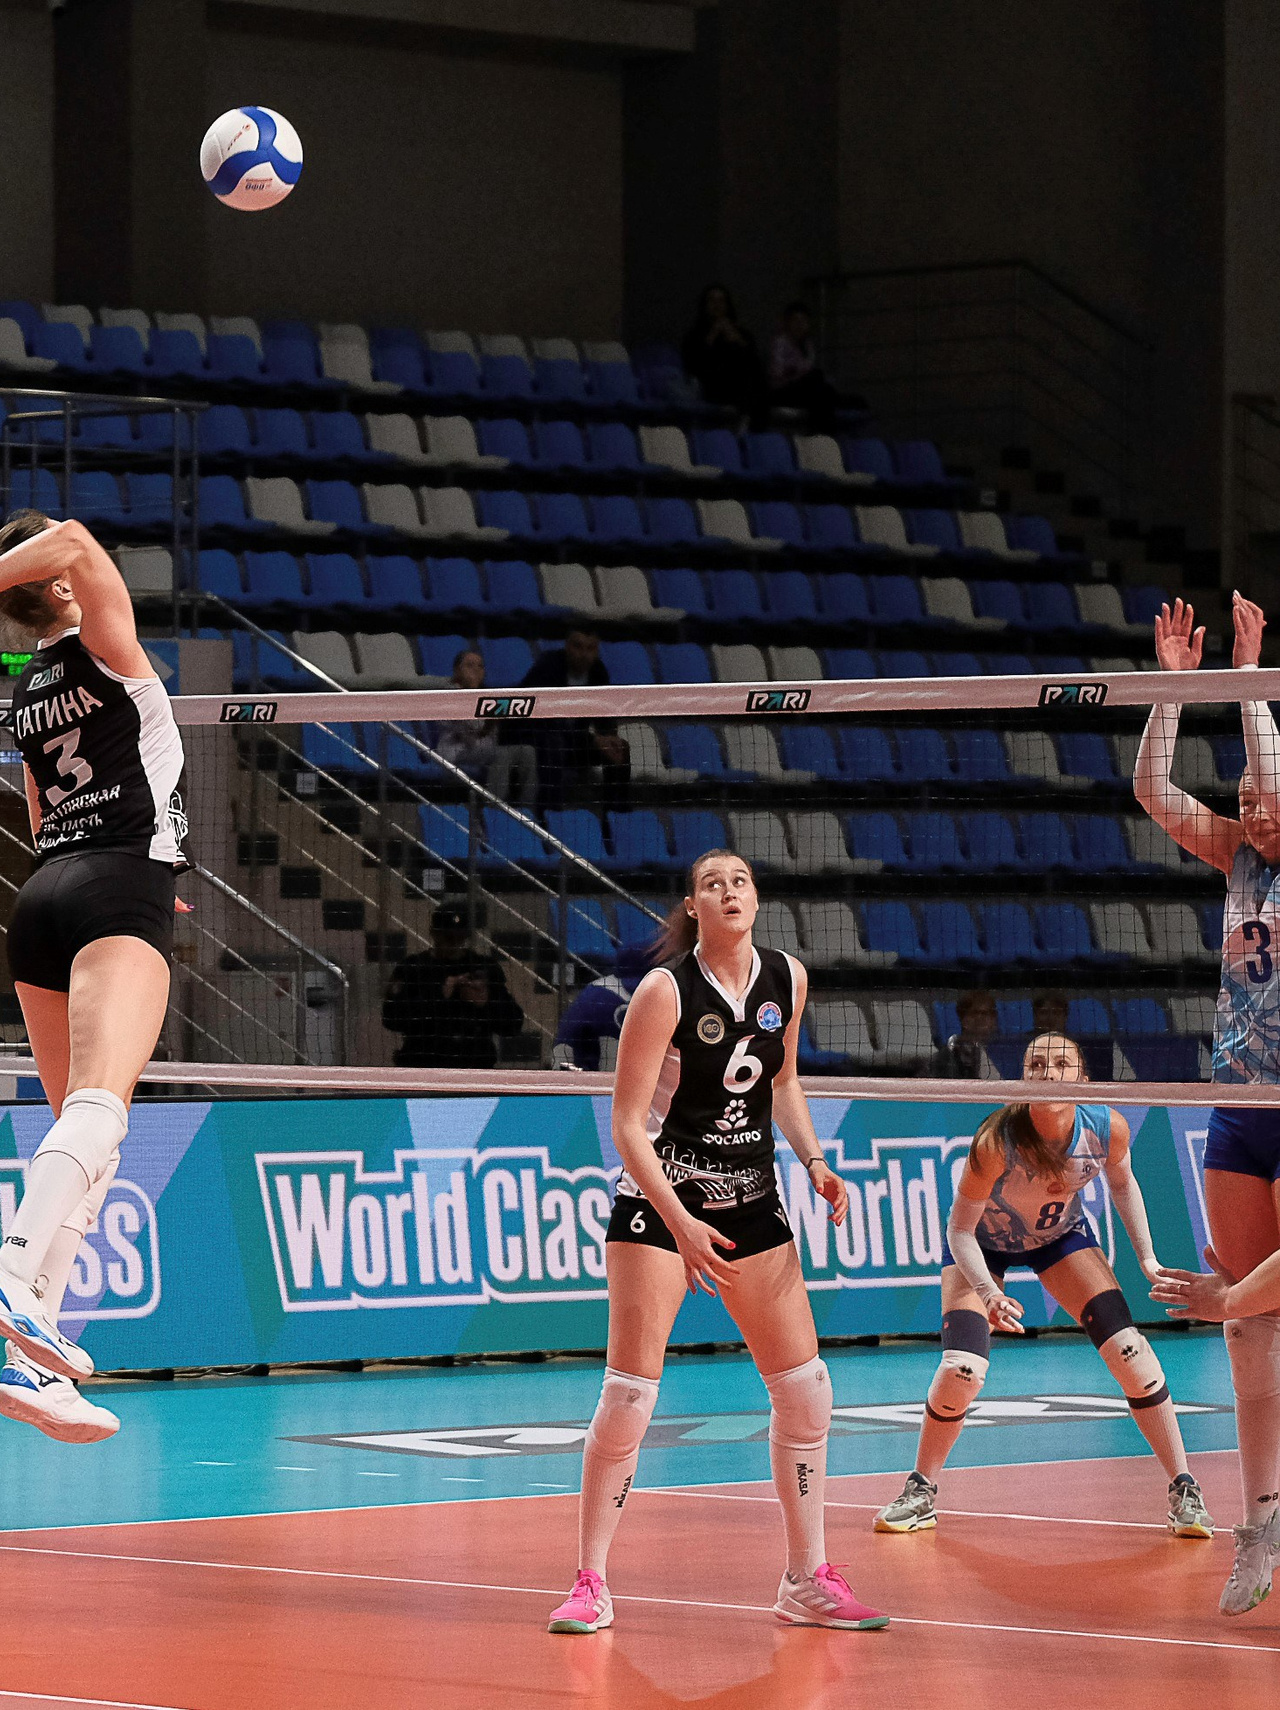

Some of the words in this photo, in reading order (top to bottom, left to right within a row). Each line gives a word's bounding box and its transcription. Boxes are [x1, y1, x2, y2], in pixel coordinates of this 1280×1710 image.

[751, 692, 806, 709] PARI
[1044, 685, 1103, 704] PARI
[225, 704, 273, 721] PARI
[480, 698, 531, 716] PARI
[42, 727, 94, 807] 3
[1242, 920, 1273, 983] 3
[723, 1034, 763, 1094] 6
[630, 1210, 646, 1234] 6
[1035, 1201, 1065, 1231] 8
[274, 1171, 474, 1290] World
[483, 1168, 613, 1283] Clas
[5, 1235, 28, 1248] rea
